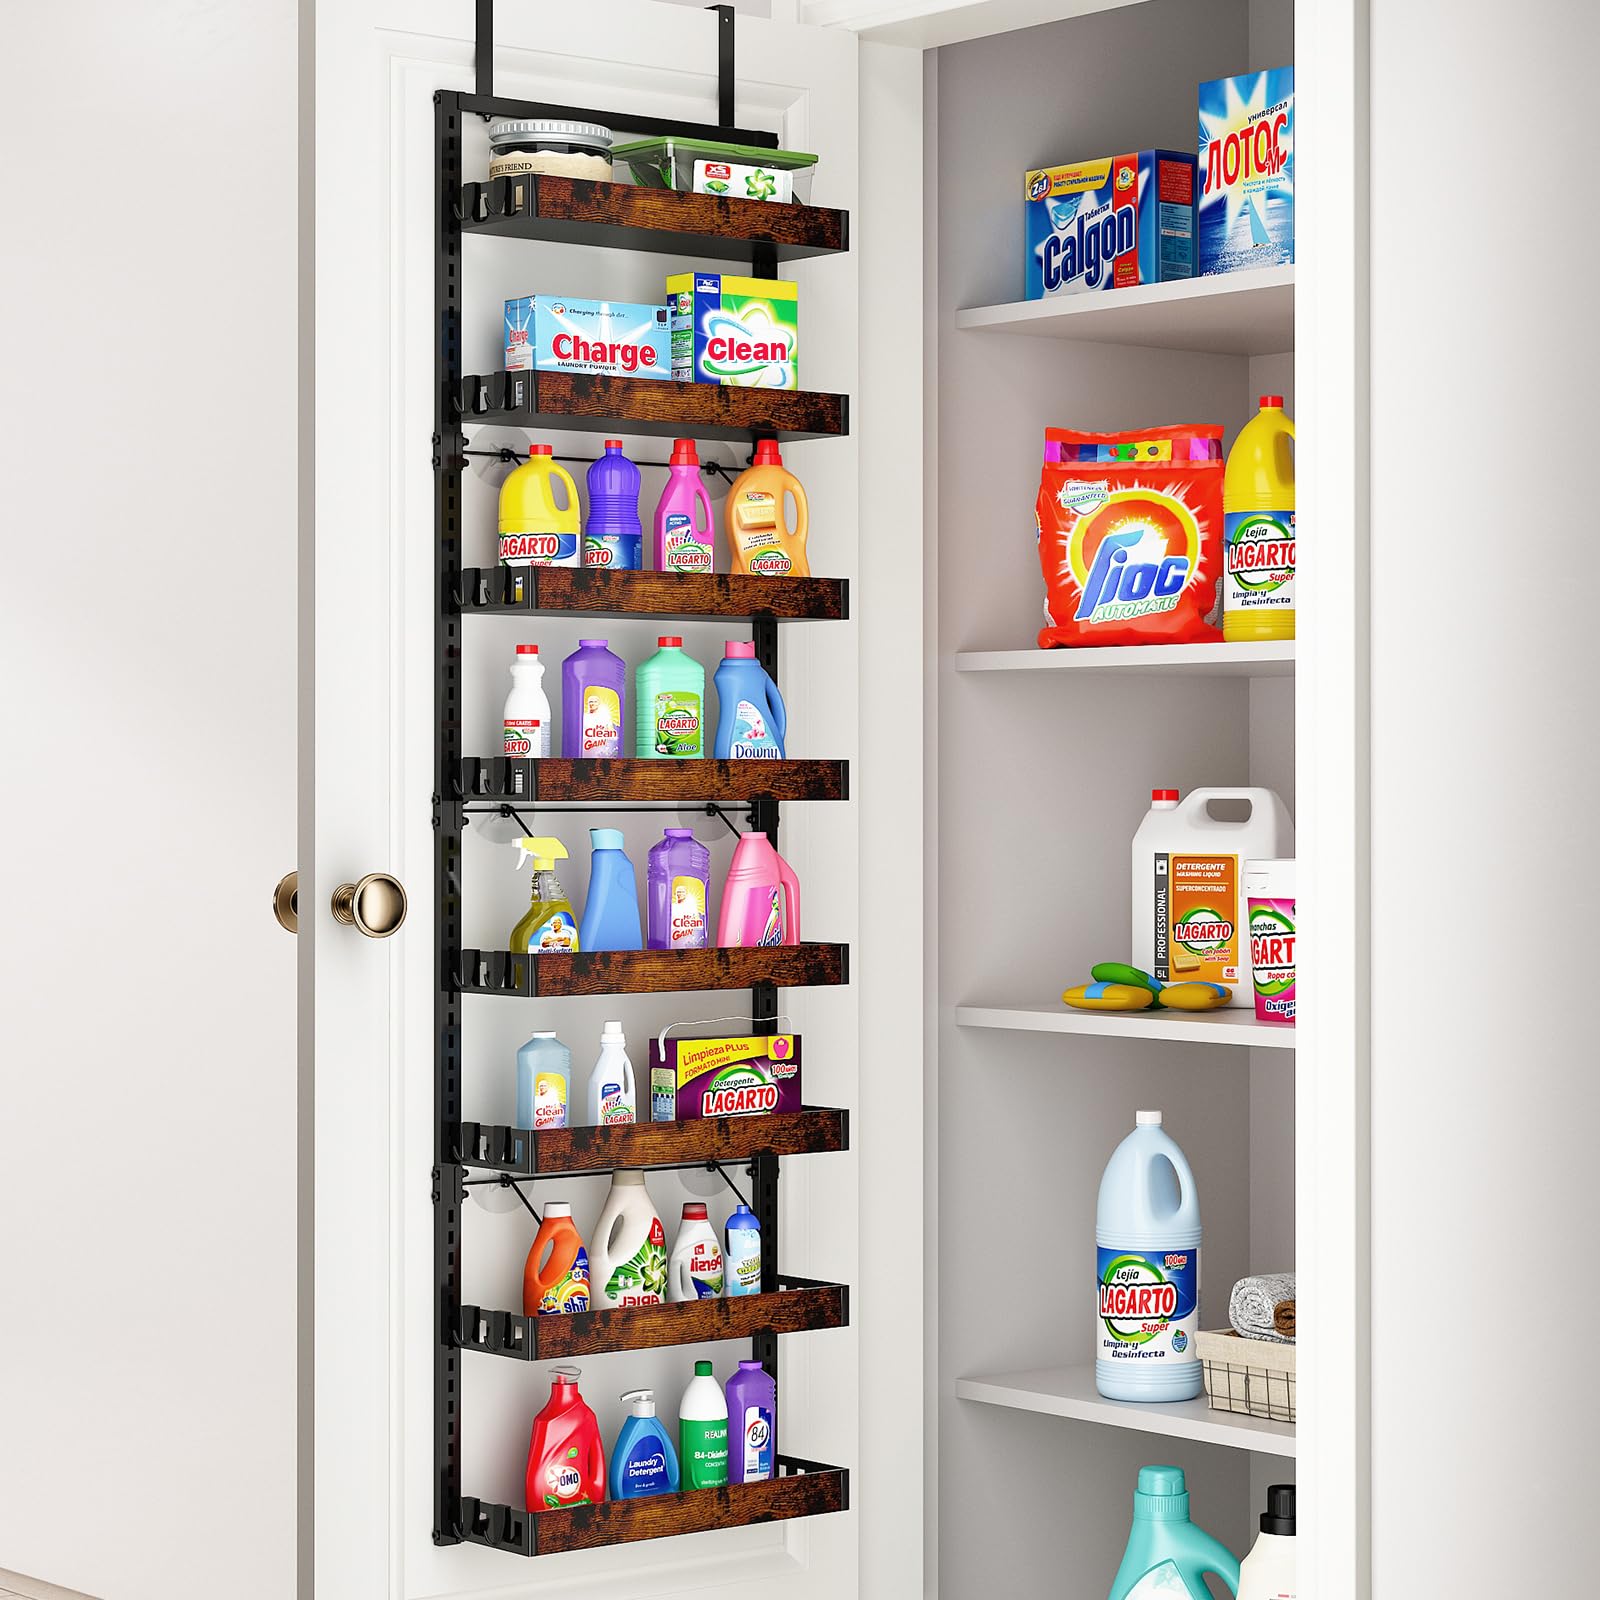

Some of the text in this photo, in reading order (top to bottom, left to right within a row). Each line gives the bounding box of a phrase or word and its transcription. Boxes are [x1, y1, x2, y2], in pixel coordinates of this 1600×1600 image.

[1248, 101, 1287, 125] универсал
[1204, 113, 1287, 195] ЛОТОС
[505, 162, 532, 171] FRIEND
[1084, 203, 1110, 222] Таблетки
[1043, 204, 1136, 292] Calgon
[569, 308, 594, 317] Charging
[552, 333, 656, 371] Charge
[707, 338, 787, 361] Clean
[1245, 526, 1268, 538] Lejía
[671, 554, 709, 565] LAGARTO
[752, 560, 790, 570] LAGARTO
[1268, 572, 1295, 584] Super
[1241, 596, 1291, 606] Desinfecta
[1091, 595, 1180, 622] AUTOMATIC
[660, 718, 697, 729] LAGARTO
[584, 728, 617, 738] Clean
[584, 739, 607, 751] GAIN
[735, 744, 778, 759] Downy
[1176, 863, 1226, 871] DETERGENTE
[1175, 885, 1227, 893] SUPERCONCENTRADO
[673, 918, 702, 927] Clean
[1157, 888, 1166, 960] PROFESSIONAL
[672, 929, 693, 940] GAIN
[1176, 925, 1230, 940] LAGARTO
[1157, 969, 1168, 978] 5L
[1267, 972, 1286, 980] Ropa
[683, 1047, 725, 1066] Limpieza
[684, 1060, 716, 1079] FORMATO
[772, 1064, 786, 1075] 100
[714, 1077, 755, 1088] Detergente
[704, 1086, 776, 1114] LAGARTO
[535, 1107, 564, 1117] Clean
[604, 1113, 633, 1124] LAGARTO
[1165, 1255, 1177, 1266] 100
[1116, 1269, 1139, 1282] Lejía
[1101, 1287, 1175, 1314] LAGARTO
[1141, 1322, 1170, 1333] Super
[1112, 1350, 1165, 1358] Desinfecta
[752, 1425, 765, 1441] 84
[629, 1458, 658, 1468] Laundry
[629, 1465, 664, 1476] Detergent
[560, 1472, 579, 1487] OMO
